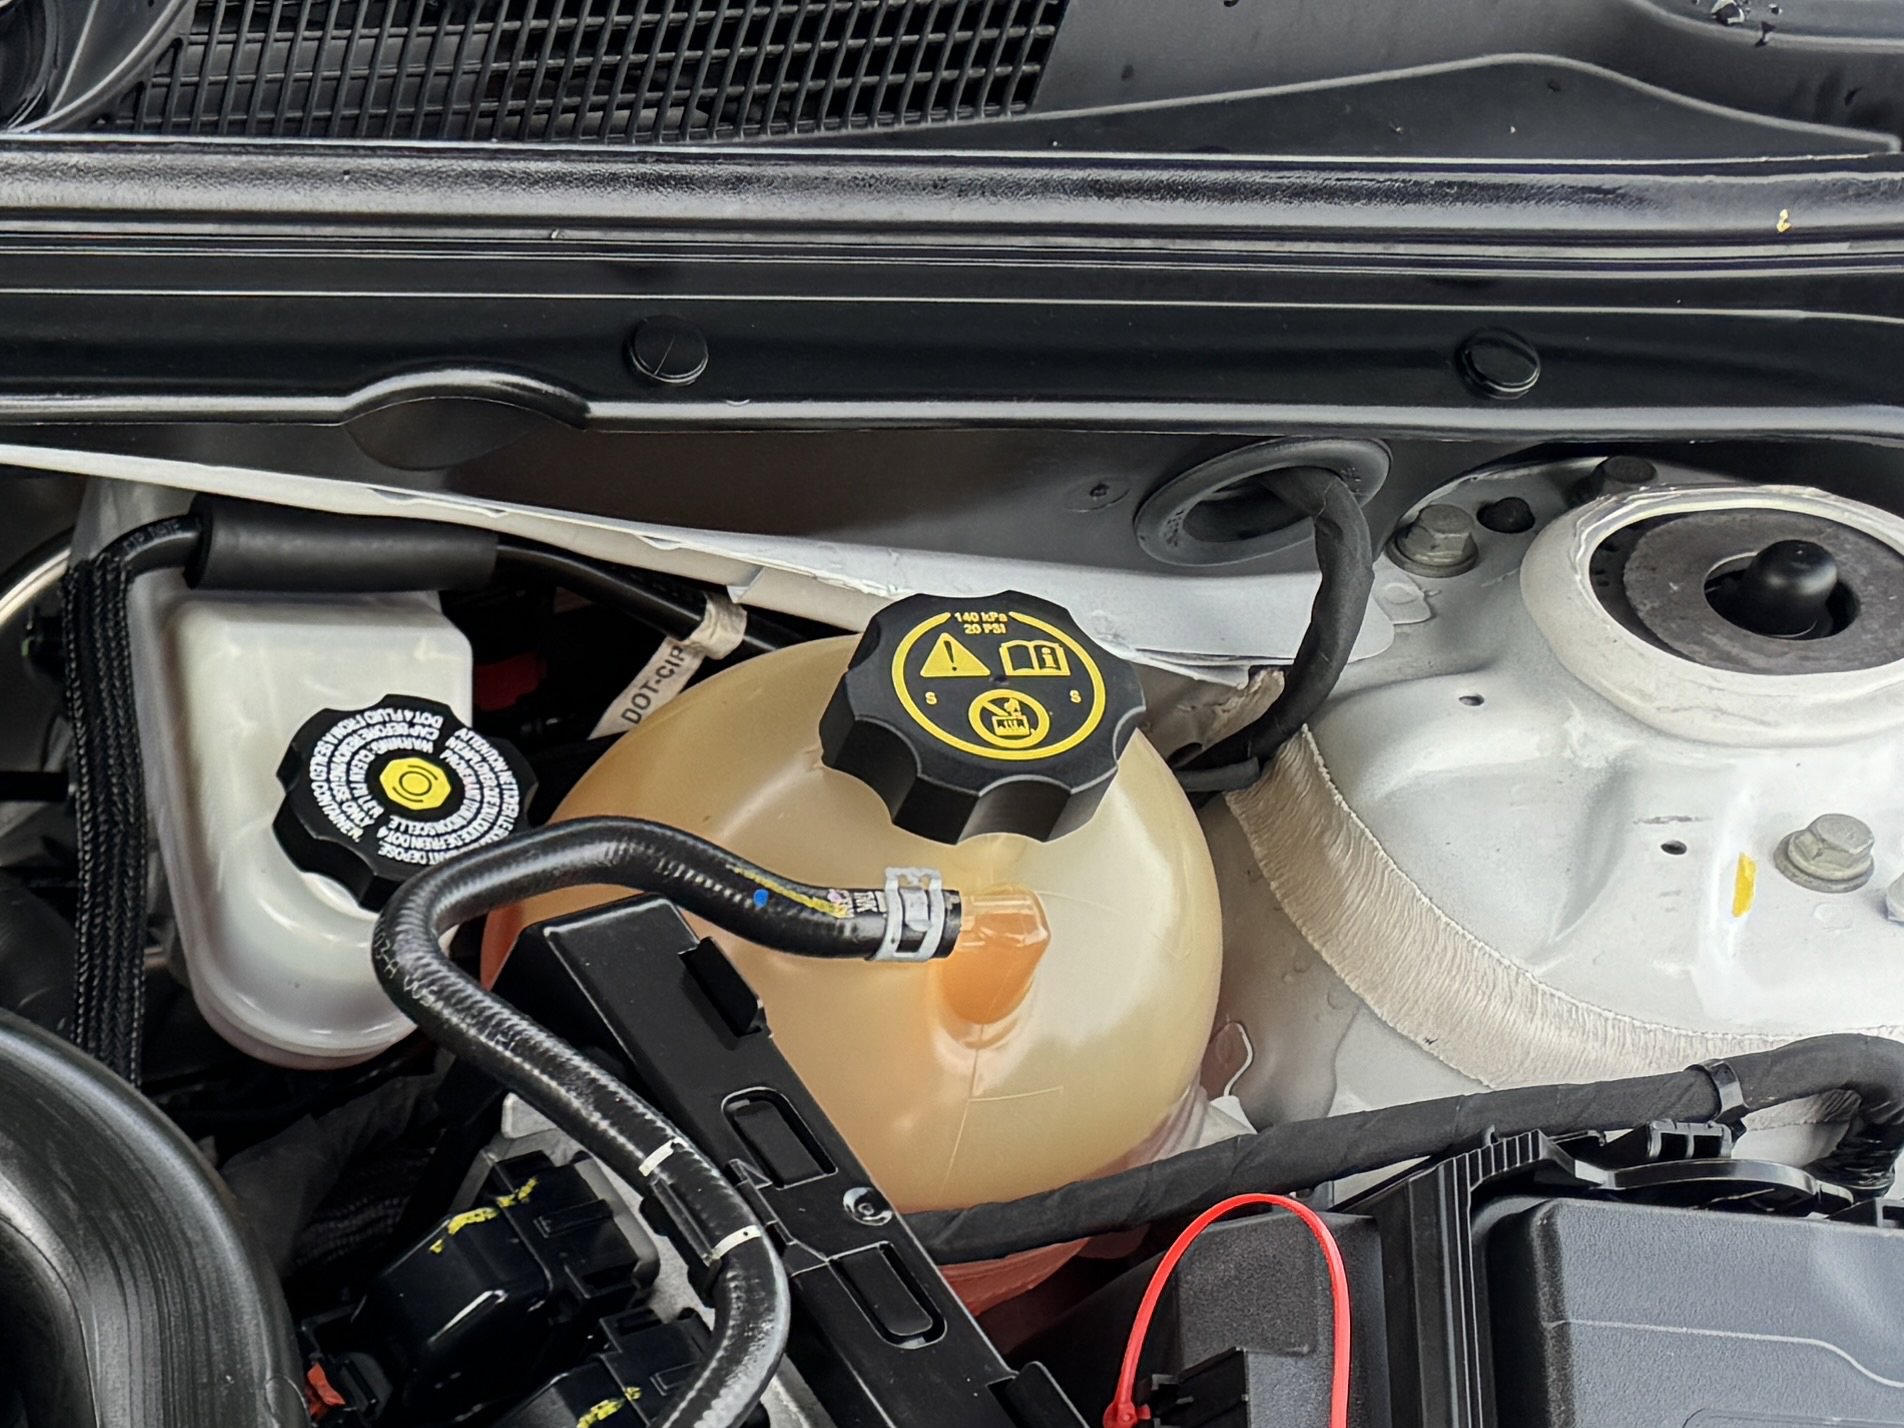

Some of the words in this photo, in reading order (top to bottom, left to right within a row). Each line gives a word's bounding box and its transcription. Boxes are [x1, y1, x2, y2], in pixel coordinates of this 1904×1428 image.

[954, 611, 980, 623] 140
[963, 623, 982, 635] 20
[982, 623, 1007, 635] PSI
